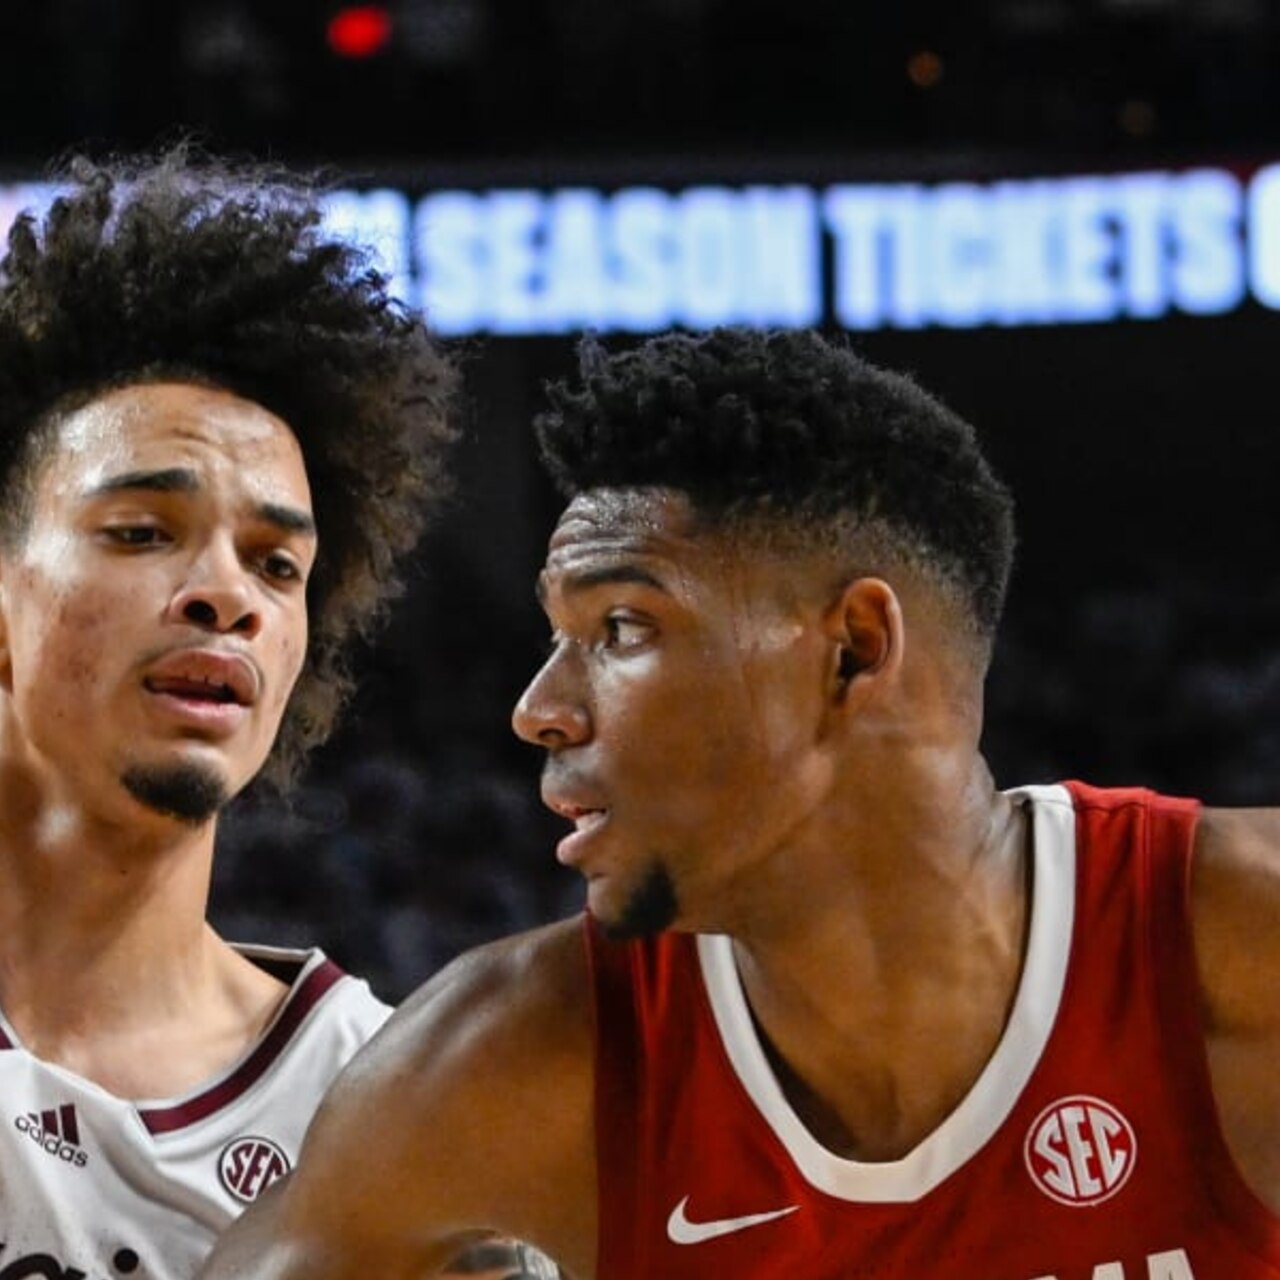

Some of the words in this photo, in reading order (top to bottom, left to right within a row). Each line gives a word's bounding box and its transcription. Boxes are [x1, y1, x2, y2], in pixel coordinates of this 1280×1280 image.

[417, 188, 821, 332] SEASON
[826, 173, 1243, 328] TICKETS
[14, 1115, 89, 1168] adidas
[1033, 1105, 1128, 1198] SEC
